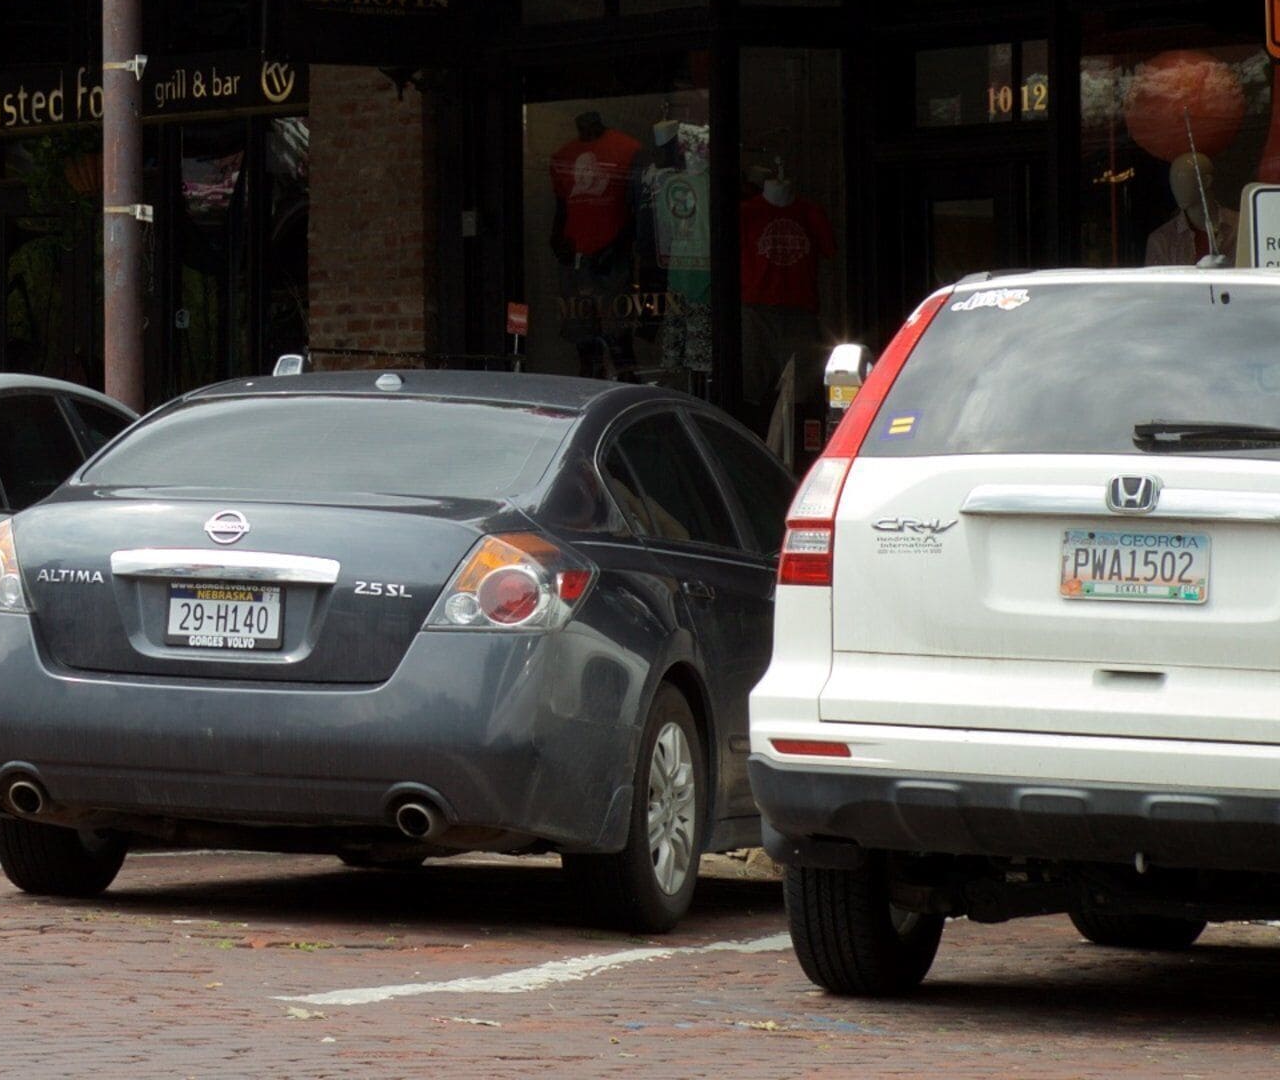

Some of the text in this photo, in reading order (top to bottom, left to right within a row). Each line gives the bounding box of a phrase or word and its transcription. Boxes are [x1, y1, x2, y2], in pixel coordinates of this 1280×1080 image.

[77, 66, 104, 120] fo
[154, 69, 186, 108] grill
[192, 70, 208, 98] &
[212, 66, 241, 97] bar
[987, 83, 1047, 115] 1012
[1266, 237, 1280, 250] R
[1119, 534, 1199, 549] GEORGIA
[1074, 548, 1194, 583] PWA1502
[37, 568, 104, 584] ALTIMA
[197, 590, 254, 601] NEBRASKA
[386, 583, 413, 598] SL
[179, 602, 269, 634] 29-H140
[189, 635, 256, 649] GORGES VOLVO
